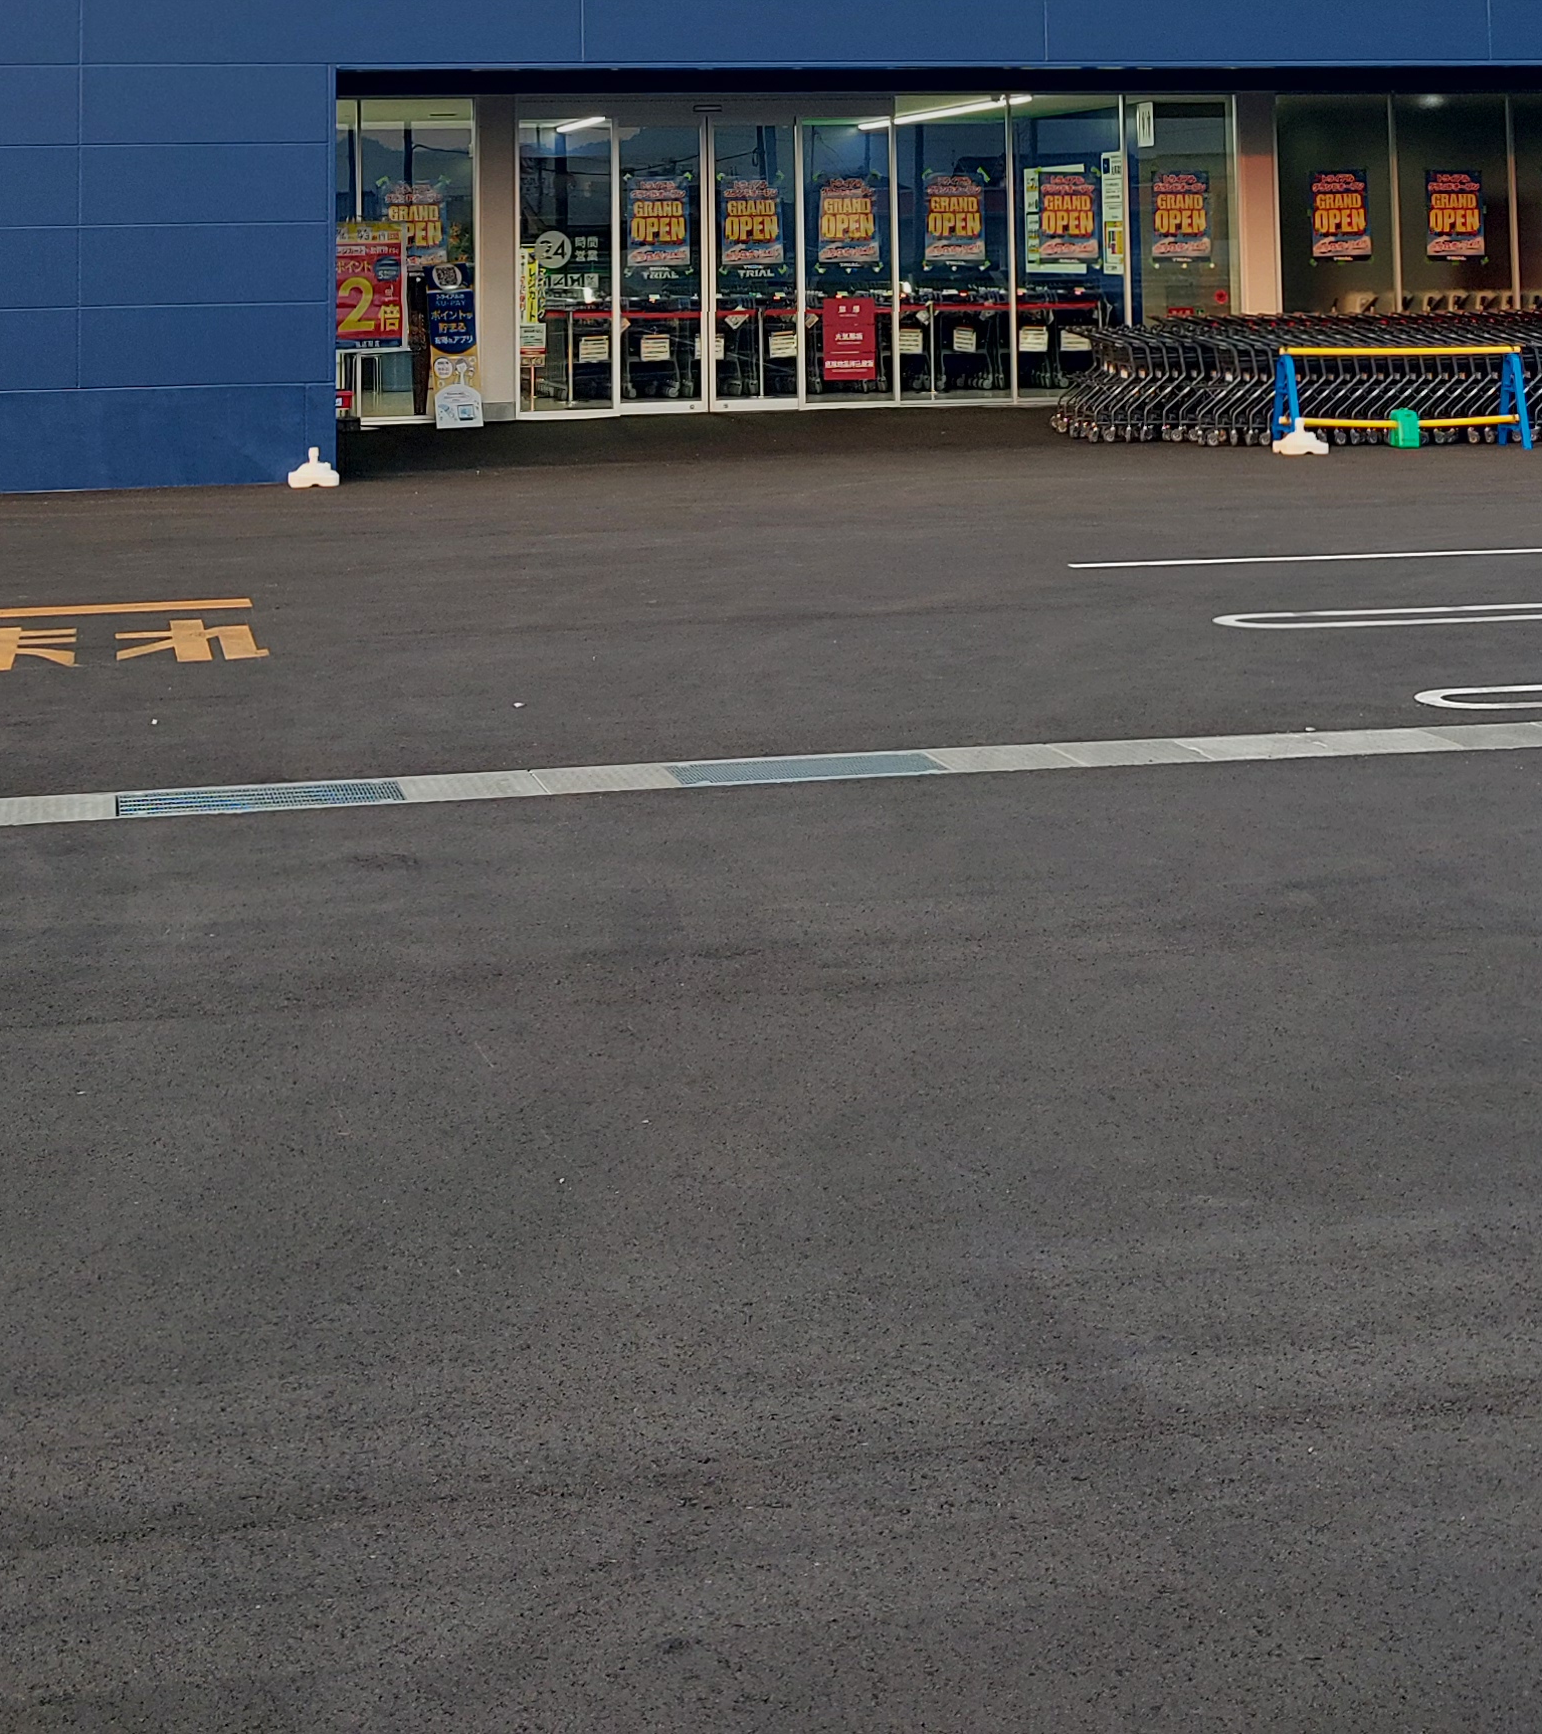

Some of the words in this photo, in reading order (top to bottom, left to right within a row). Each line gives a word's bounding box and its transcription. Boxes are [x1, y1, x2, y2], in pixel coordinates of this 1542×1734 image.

[633, 200, 683, 217] GRAND
[727, 199, 776, 216] GRAND
[823, 198, 872, 214] GRAND
[930, 196, 979, 212] GRAND
[1044, 195, 1092, 211] GRAND
[1157, 194, 1204, 210] GRAND
[1316, 193, 1362, 209] GRAND
[1431, 193, 1477, 209] GRAND
[388, 205, 440, 222] GRAND
[1155, 209, 1207, 234] OPEN
[1314, 209, 1366, 234] OPEN
[1429, 208, 1480, 234] OPEN
[631, 217, 686, 242] OPEN
[725, 215, 779, 241] OPEN
[821, 213, 875, 239] OPEN
[928, 212, 982, 237] OPEN
[1042, 211, 1095, 236] OPEN
[407, 221, 442, 246] PEN
[575, 236, 598, 247] 時間
[540, 239, 567, 259] 24
[642, 271, 679, 279] TRIAL
[737, 269, 775, 278] TRIAL
